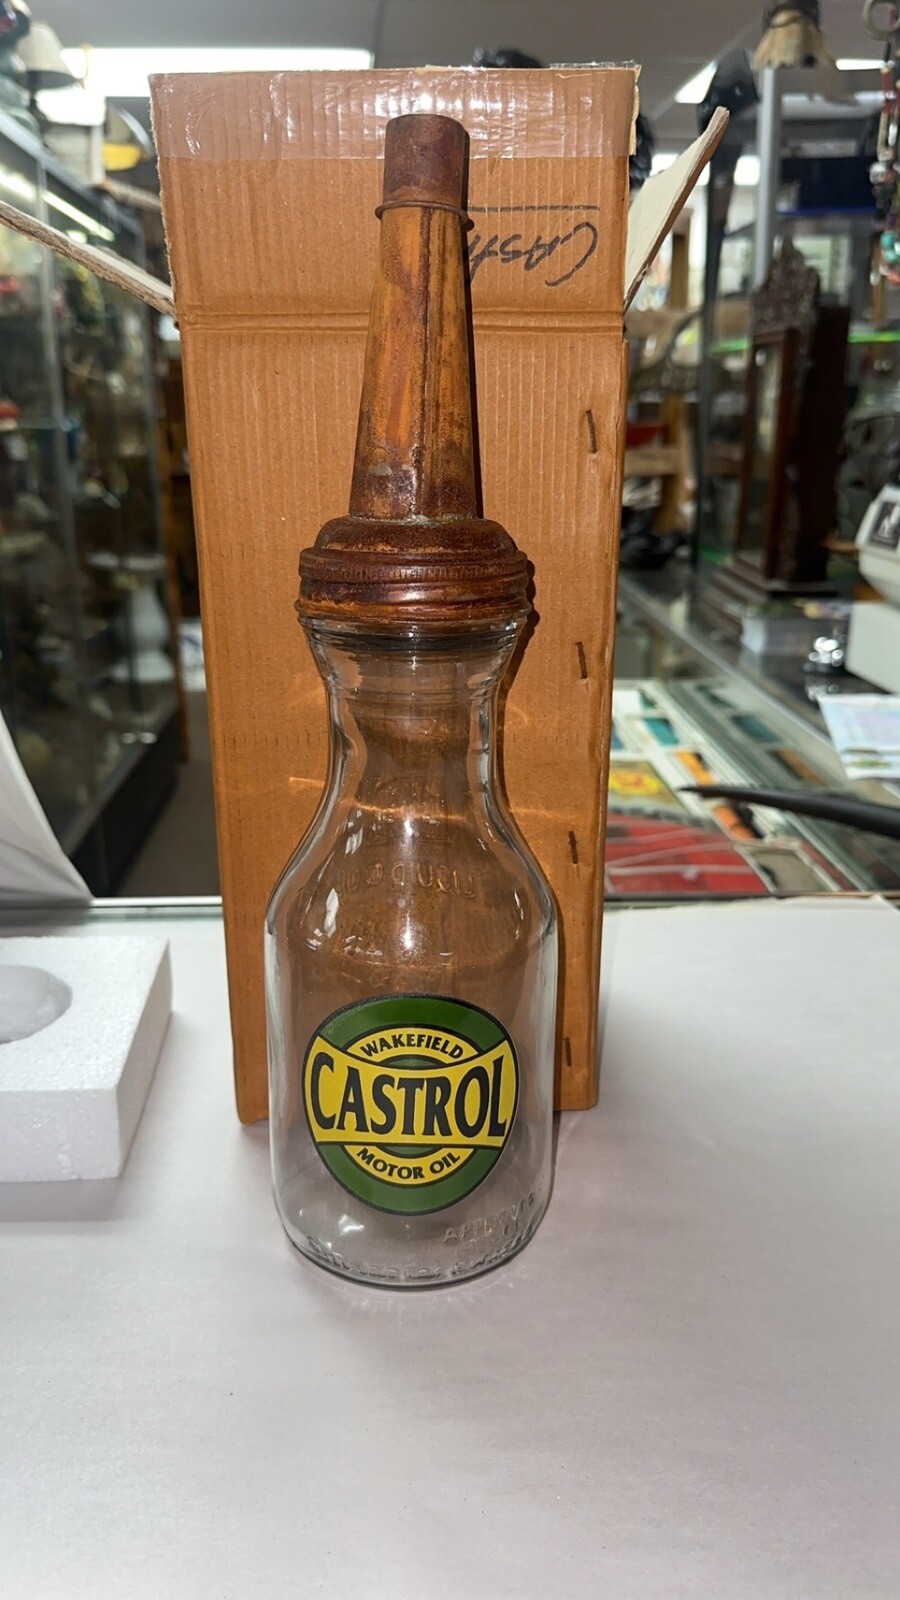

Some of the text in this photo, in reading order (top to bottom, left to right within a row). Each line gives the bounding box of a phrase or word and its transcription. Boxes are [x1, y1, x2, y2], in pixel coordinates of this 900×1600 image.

[360, 1034, 464, 1059] WAKEFIELD
[310, 1051, 508, 1138] CASTROL
[356, 1147, 461, 1180] MOTOR OIL
